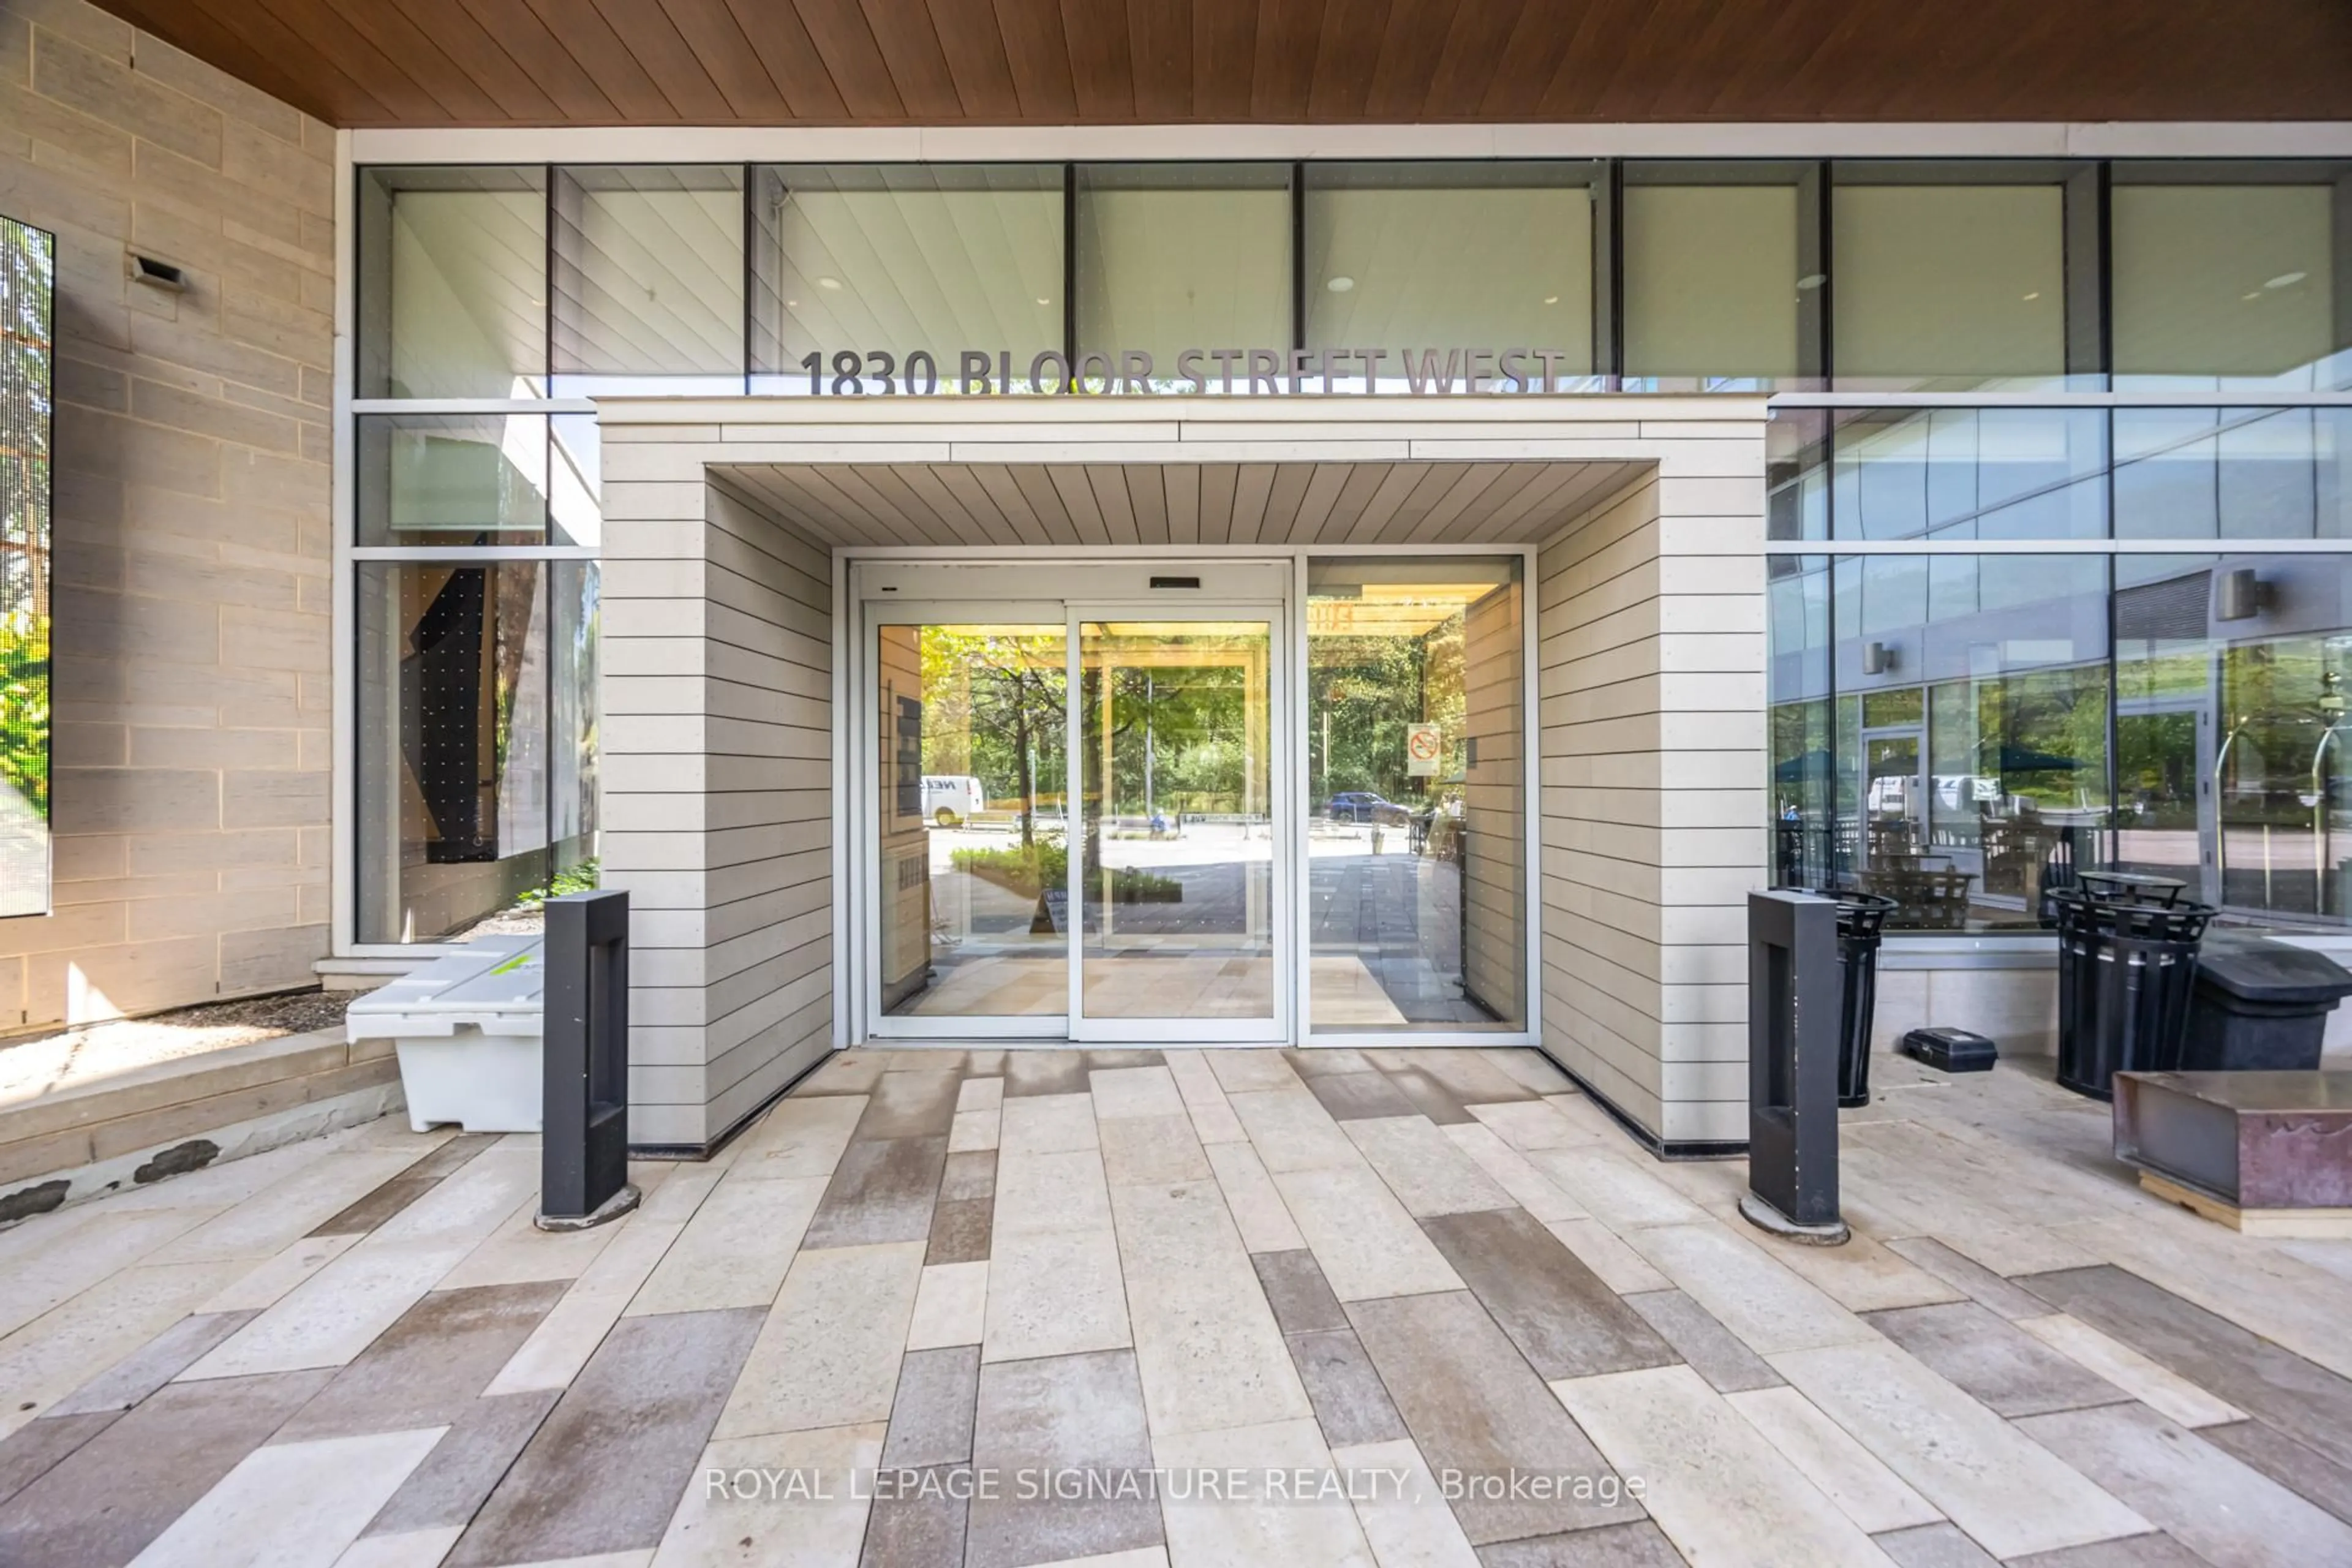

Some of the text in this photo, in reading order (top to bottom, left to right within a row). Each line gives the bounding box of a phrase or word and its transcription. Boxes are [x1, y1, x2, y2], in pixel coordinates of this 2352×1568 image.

[800, 348, 1566, 395] 1830 BLOOR STREET WEST
